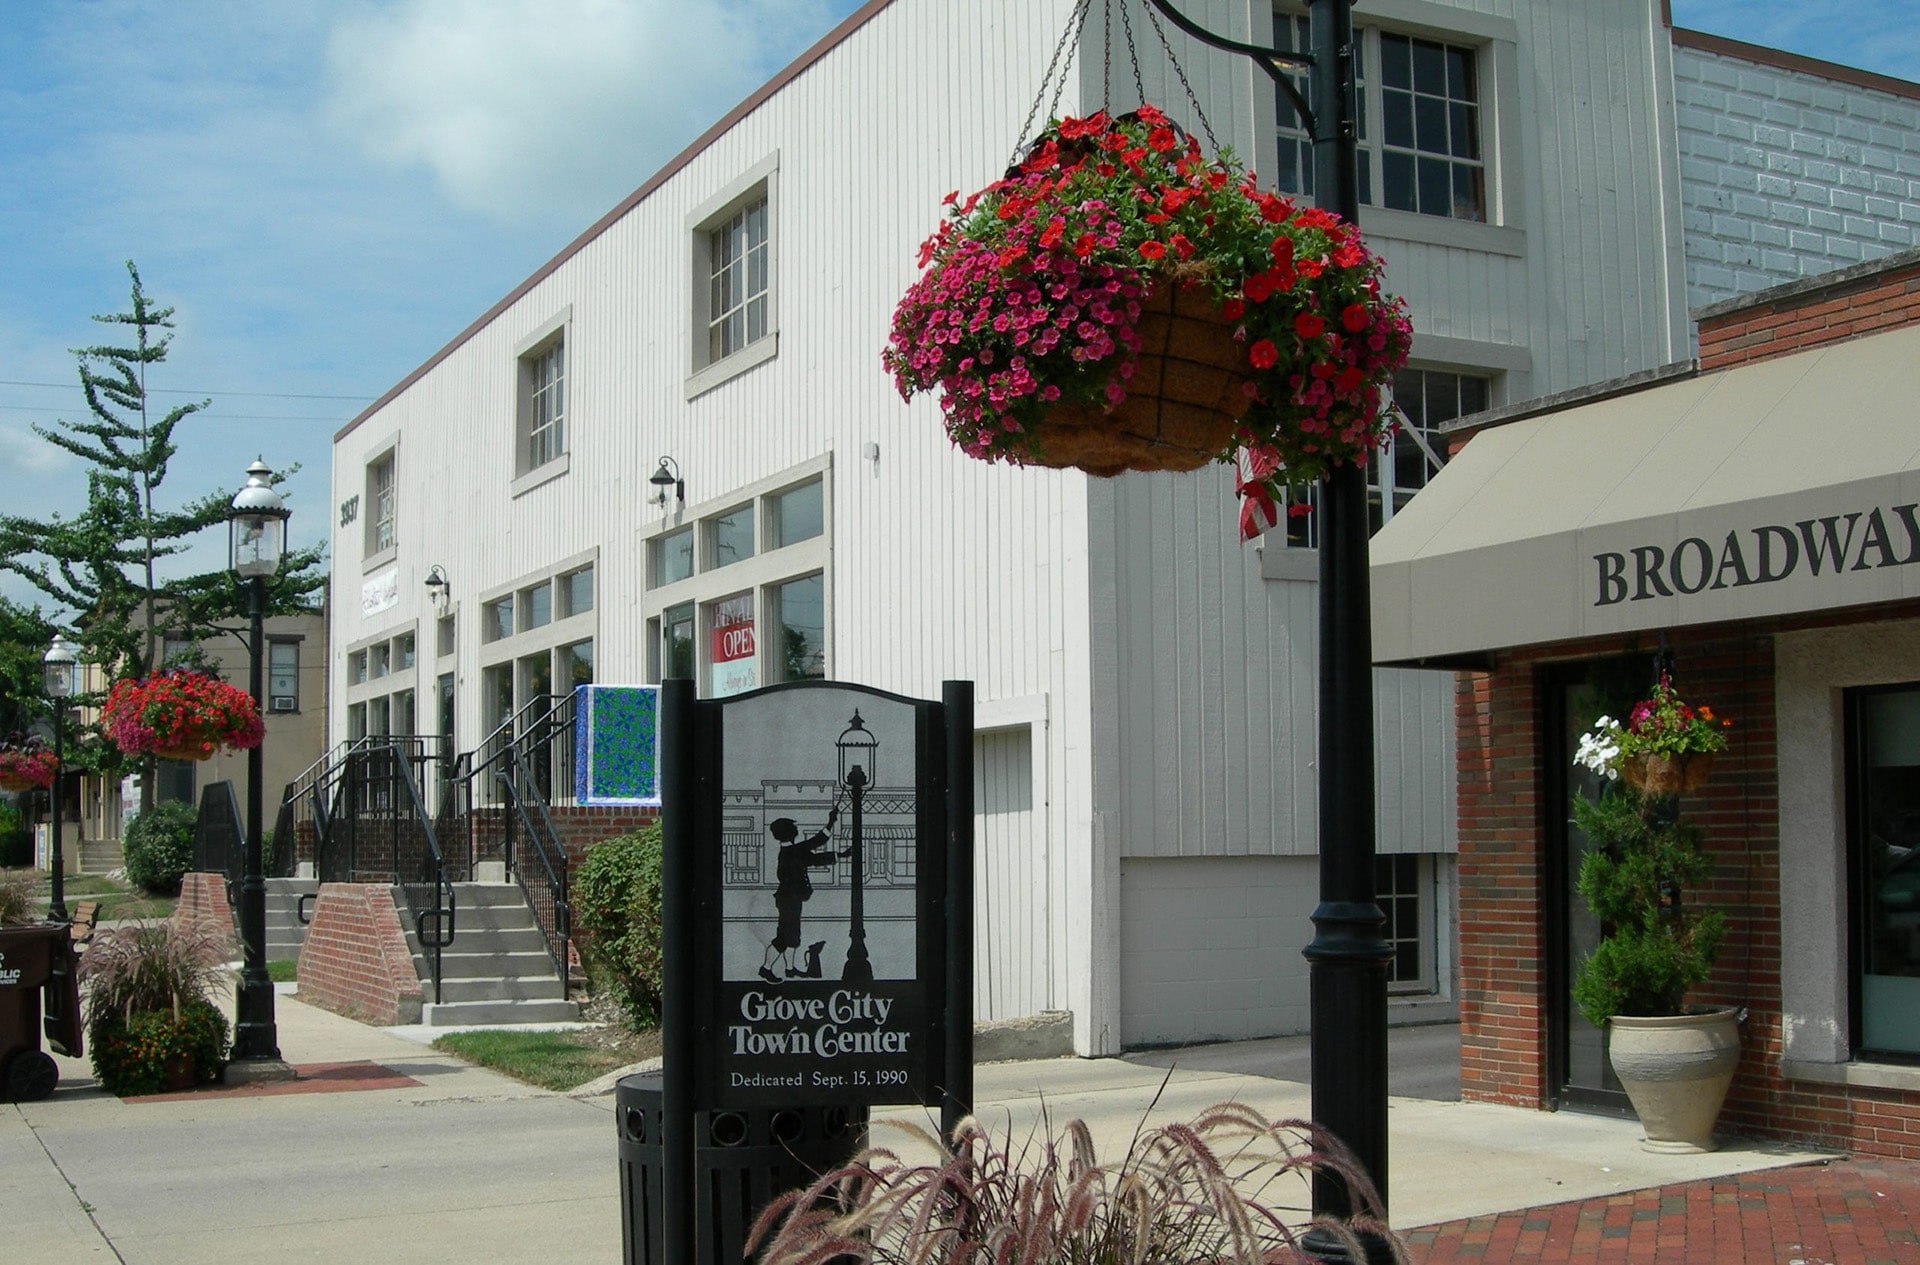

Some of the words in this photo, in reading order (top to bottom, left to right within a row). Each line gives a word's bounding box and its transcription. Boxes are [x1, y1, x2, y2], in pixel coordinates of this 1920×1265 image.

[723, 627, 755, 658] OPEN
[740, 991, 825, 1022] Grove
[828, 989, 894, 1025] City
[728, 1025, 811, 1055] Town
[814, 1023, 911, 1058] Center
[730, 1072, 803, 1087] Dedicated
[812, 1070, 848, 1088] Sept.
[853, 1070, 870, 1086] 15,
[876, 1069, 908, 1085] 1990
